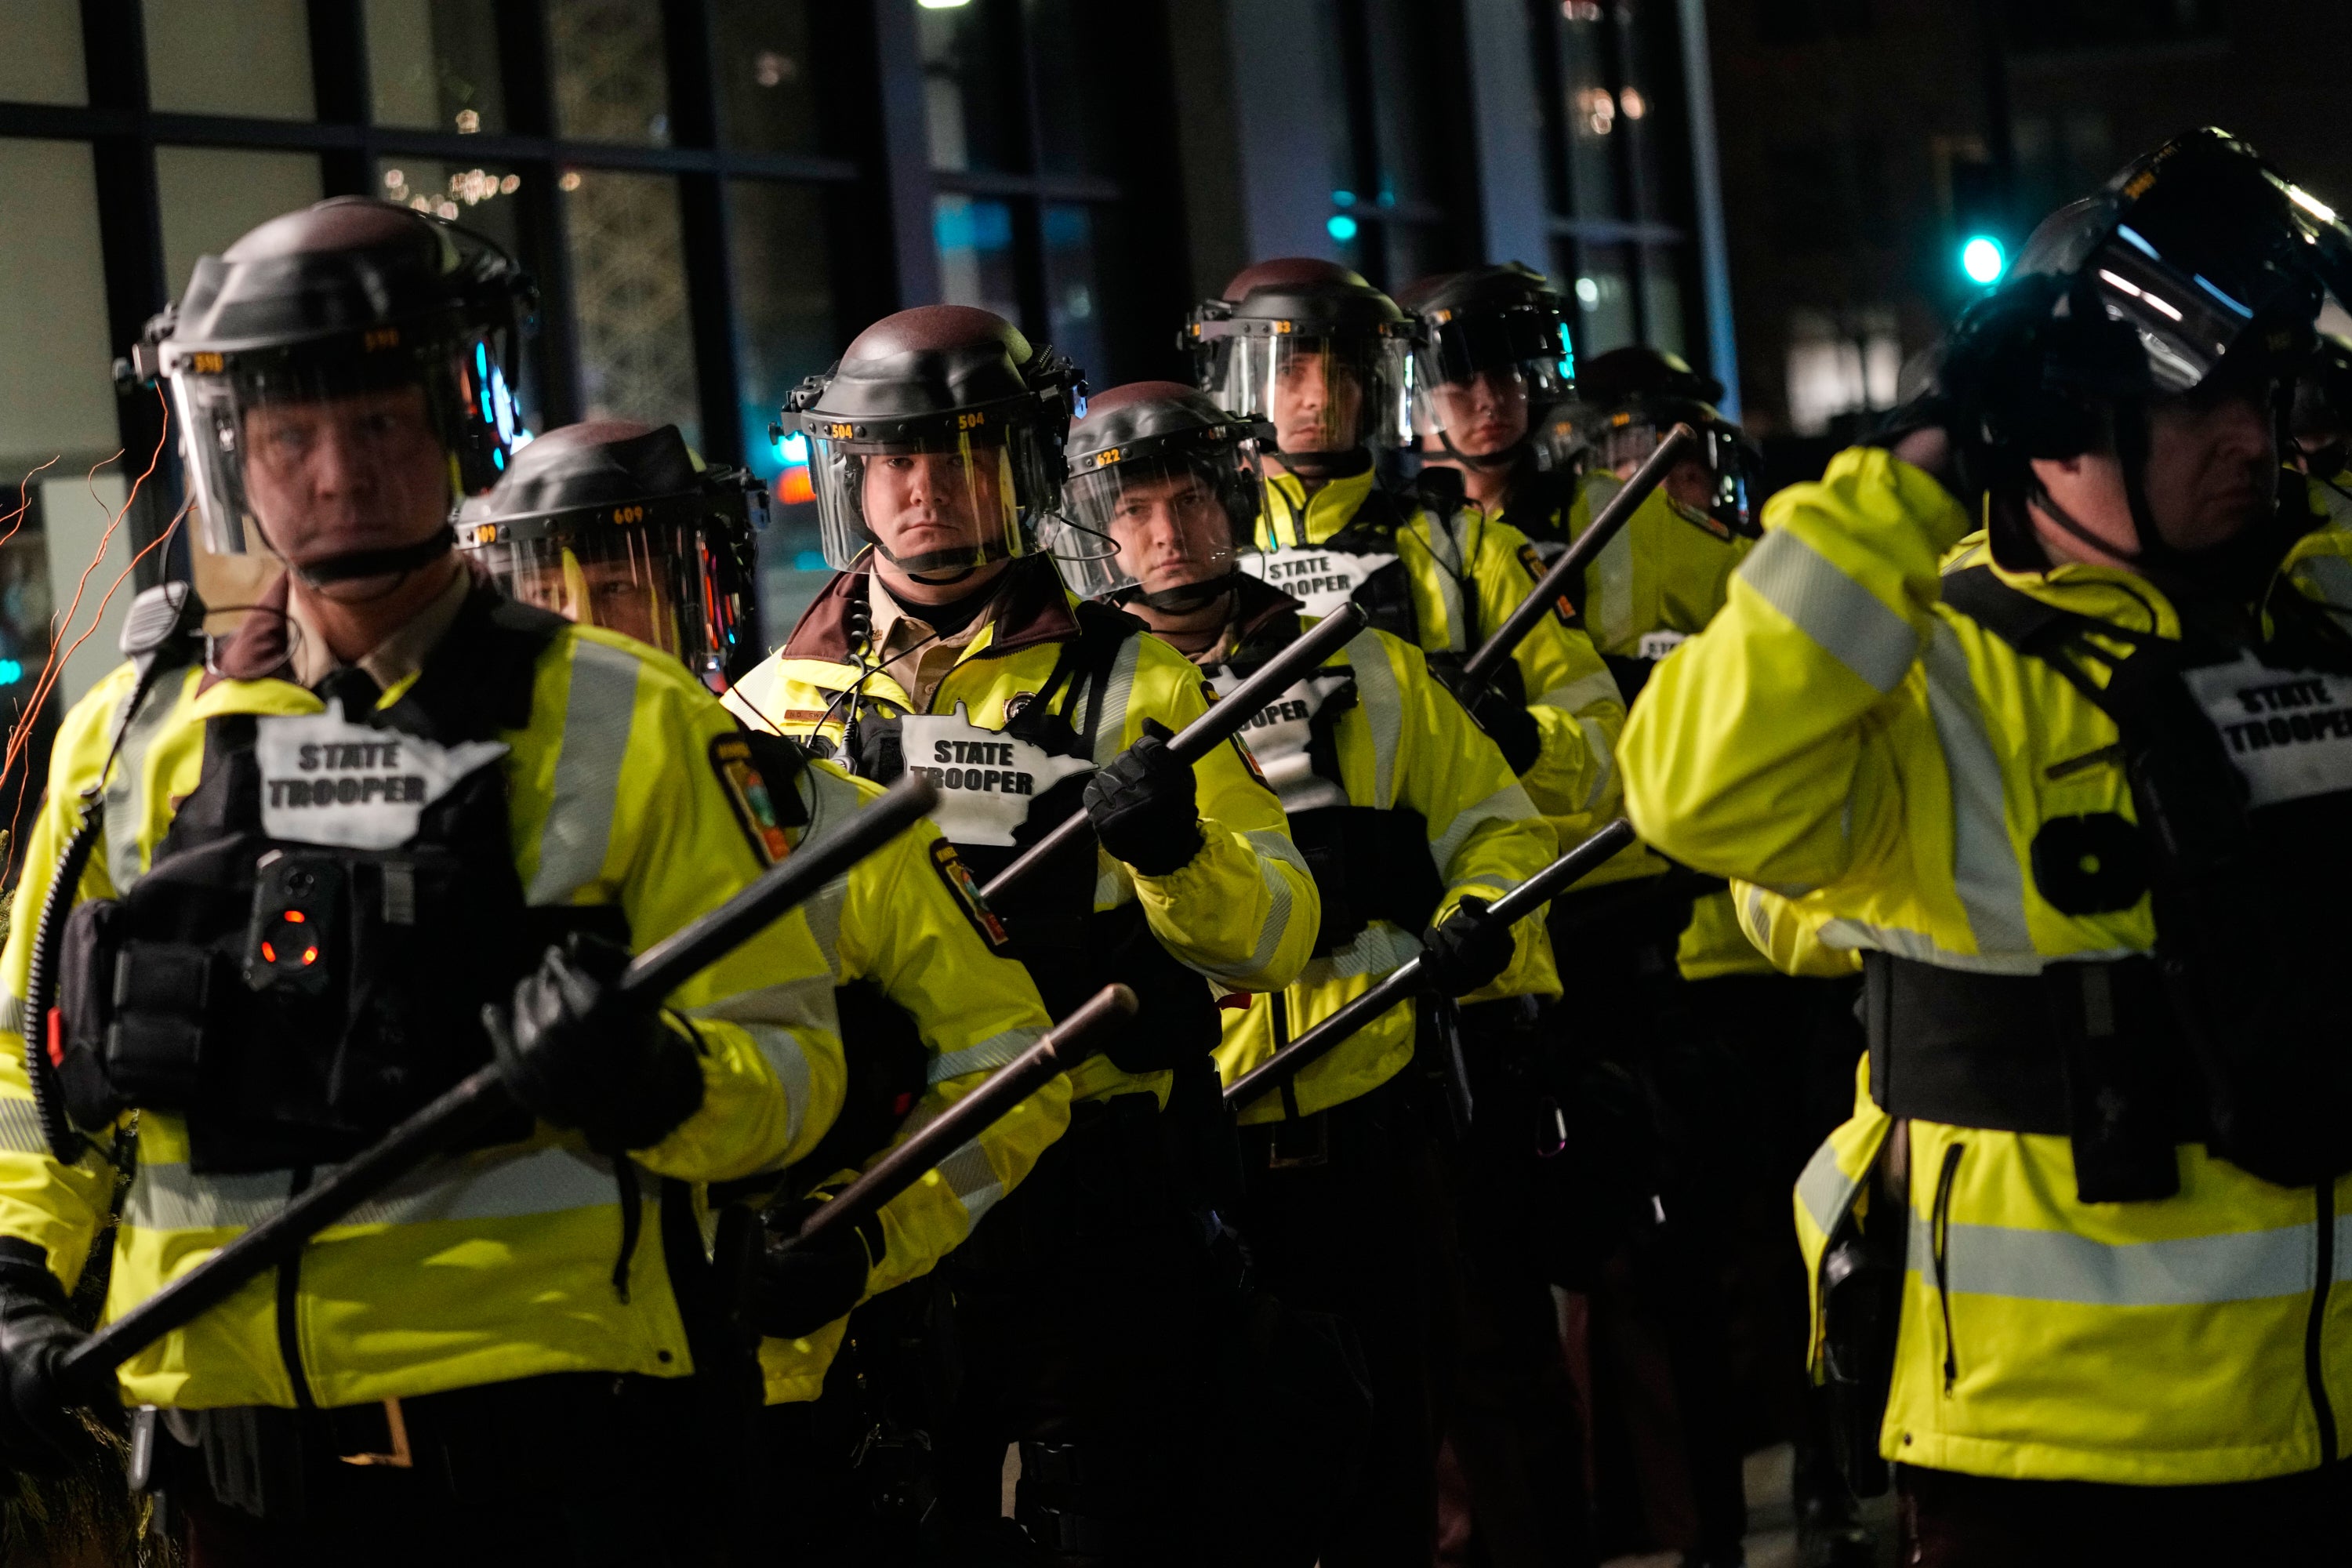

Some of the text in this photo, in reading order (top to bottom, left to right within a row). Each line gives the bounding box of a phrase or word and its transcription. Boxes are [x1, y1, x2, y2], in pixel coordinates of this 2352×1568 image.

[833, 424, 853, 439] 504
[958, 412, 985, 430] 504
[1096, 448, 1120, 466] 622
[613, 504, 644, 525] 609
[1269, 557, 1330, 579] STATE
[1282, 575, 1351, 596] OOPER
[2237, 679, 2332, 713] STATE
[299, 742, 398, 771] STATE
[935, 739, 1014, 766] STATE
[268, 774, 426, 808] TROOPER
